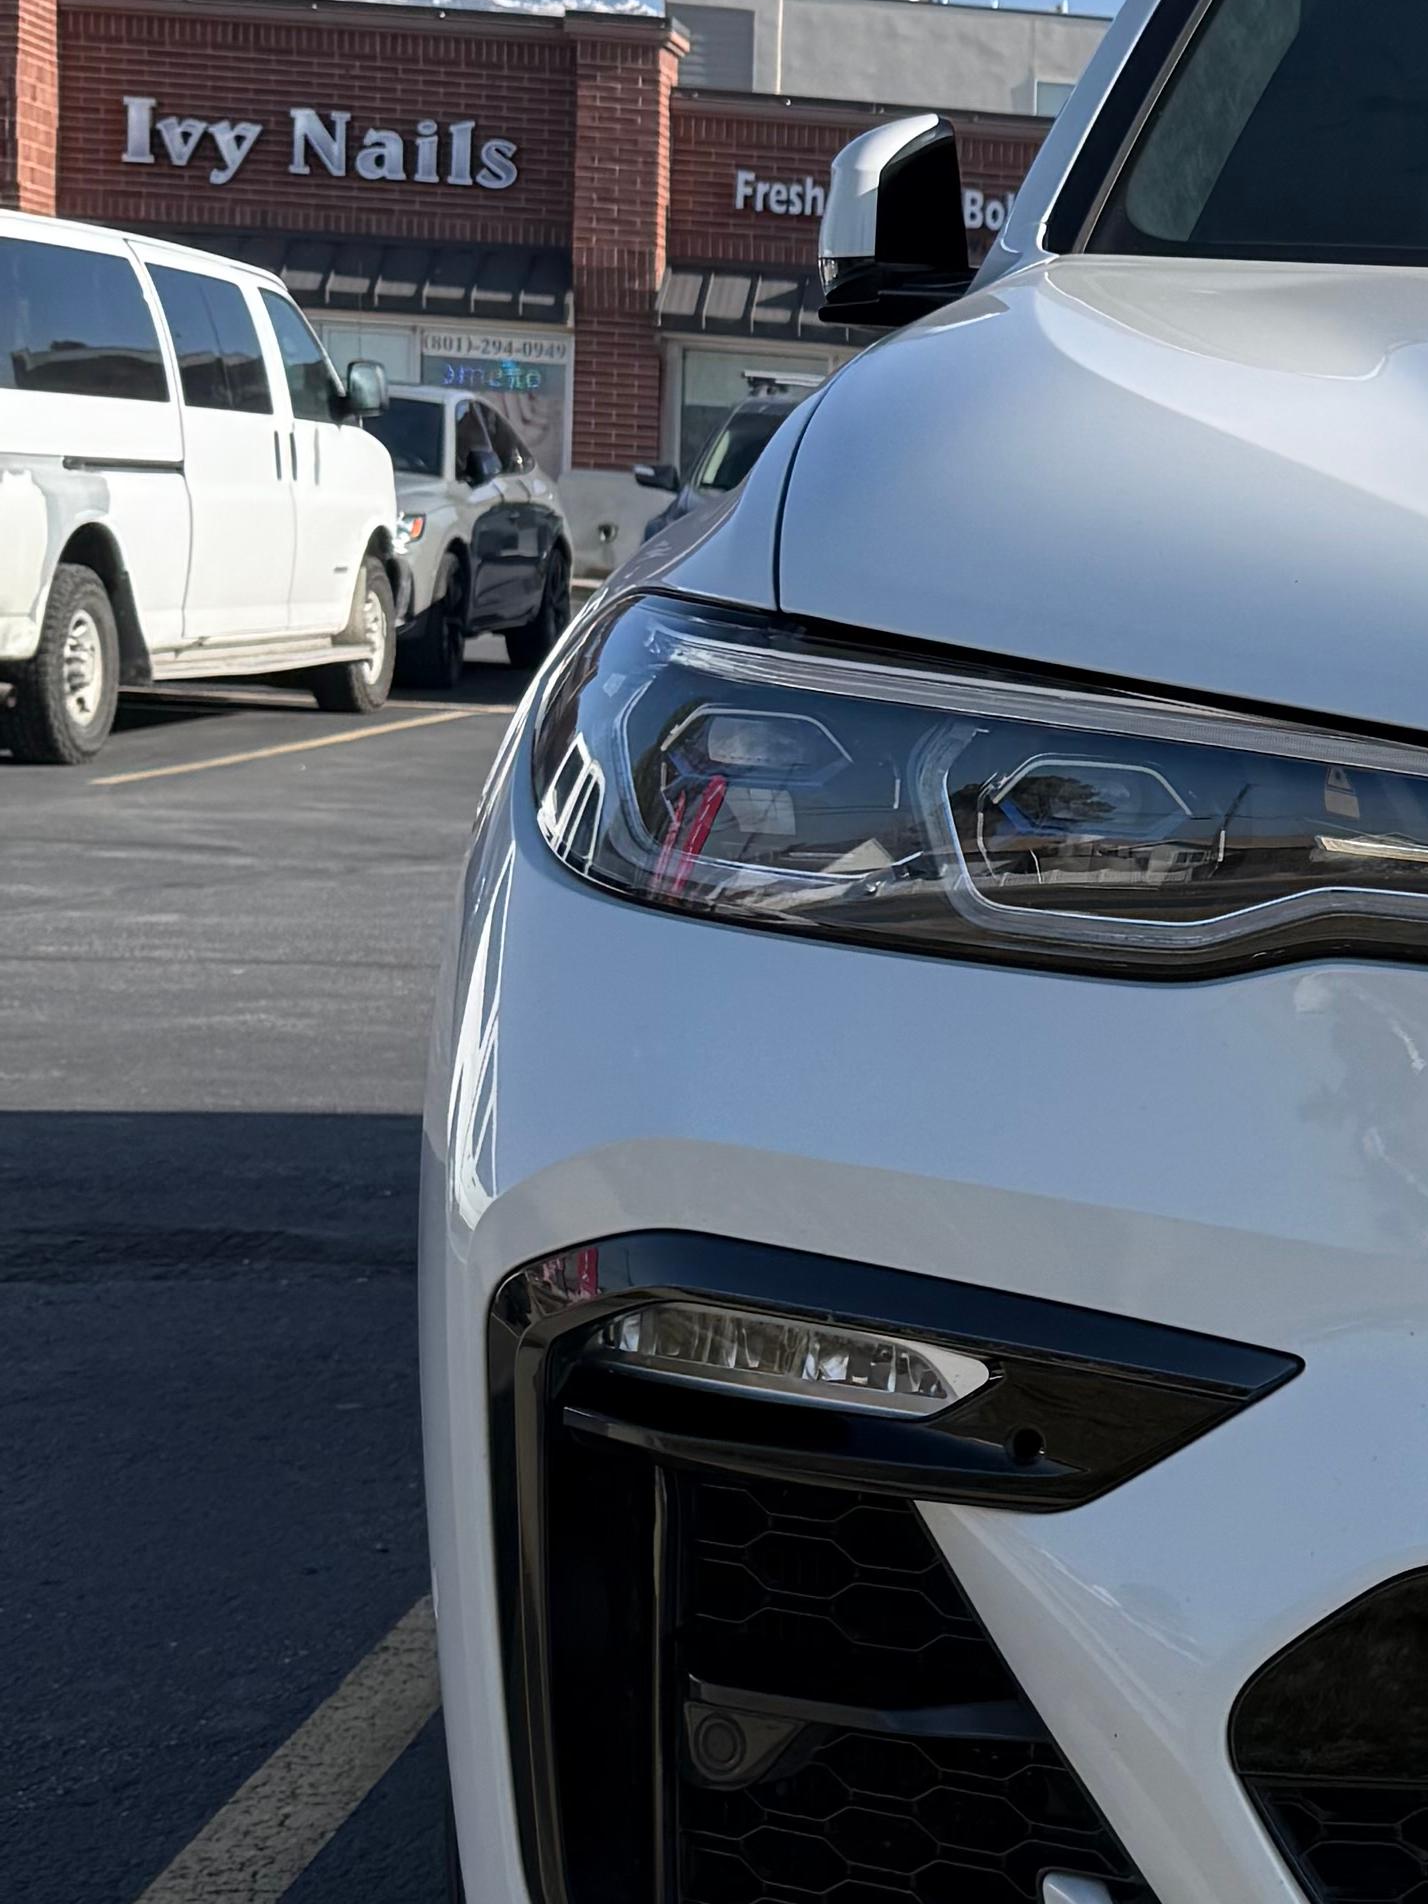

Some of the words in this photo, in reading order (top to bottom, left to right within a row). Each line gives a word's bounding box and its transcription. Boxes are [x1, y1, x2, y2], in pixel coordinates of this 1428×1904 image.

[121, 96, 263, 185] Ivy
[287, 107, 519, 190] Nails
[734, 169, 825, 217] Fresh
